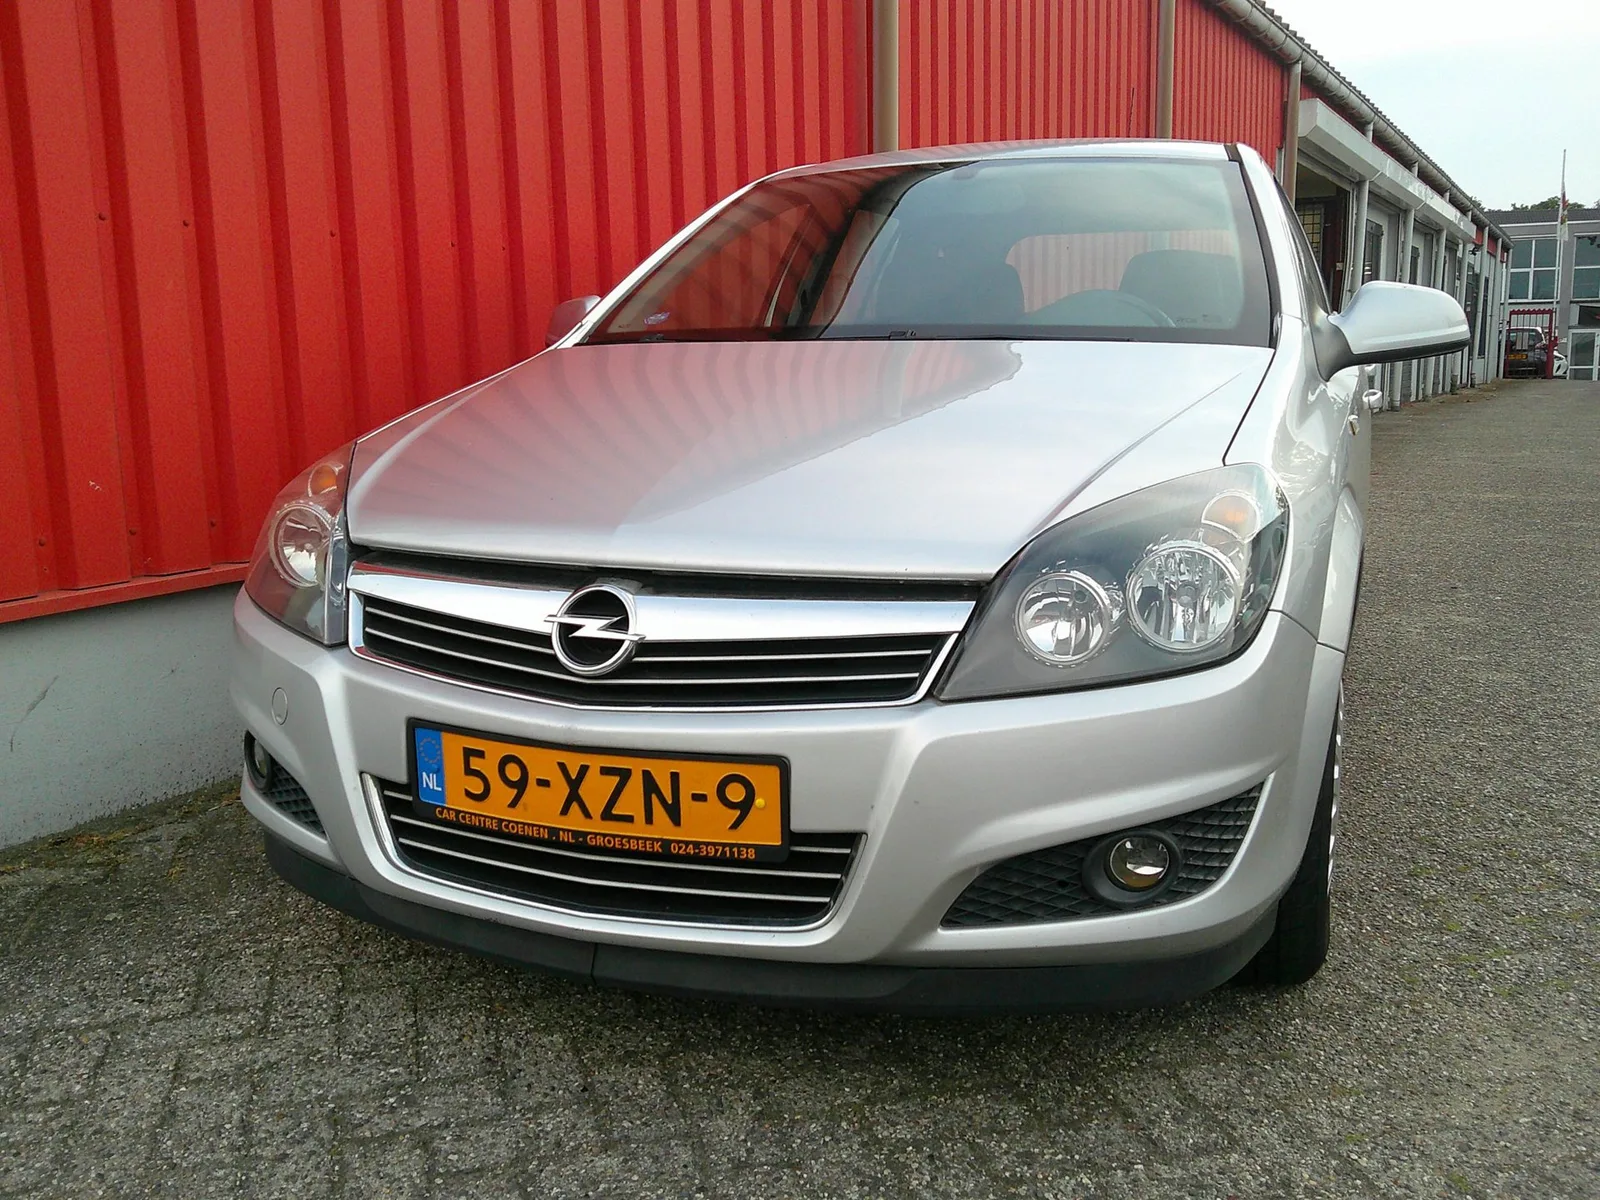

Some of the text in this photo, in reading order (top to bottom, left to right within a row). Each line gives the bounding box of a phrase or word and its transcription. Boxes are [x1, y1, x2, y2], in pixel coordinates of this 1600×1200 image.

[422, 771, 442, 791] NL
[462, 746, 756, 830] 59-XZN-9
[435, 807, 456, 821] CAR
[458, 812, 499, 831] CENTRE
[501, 821, 548, 839] COENEN
[559, 831, 575, 844] NL
[587, 834, 662, 853] GROESBEEK
[670, 842, 755, 860] 024-3971138
